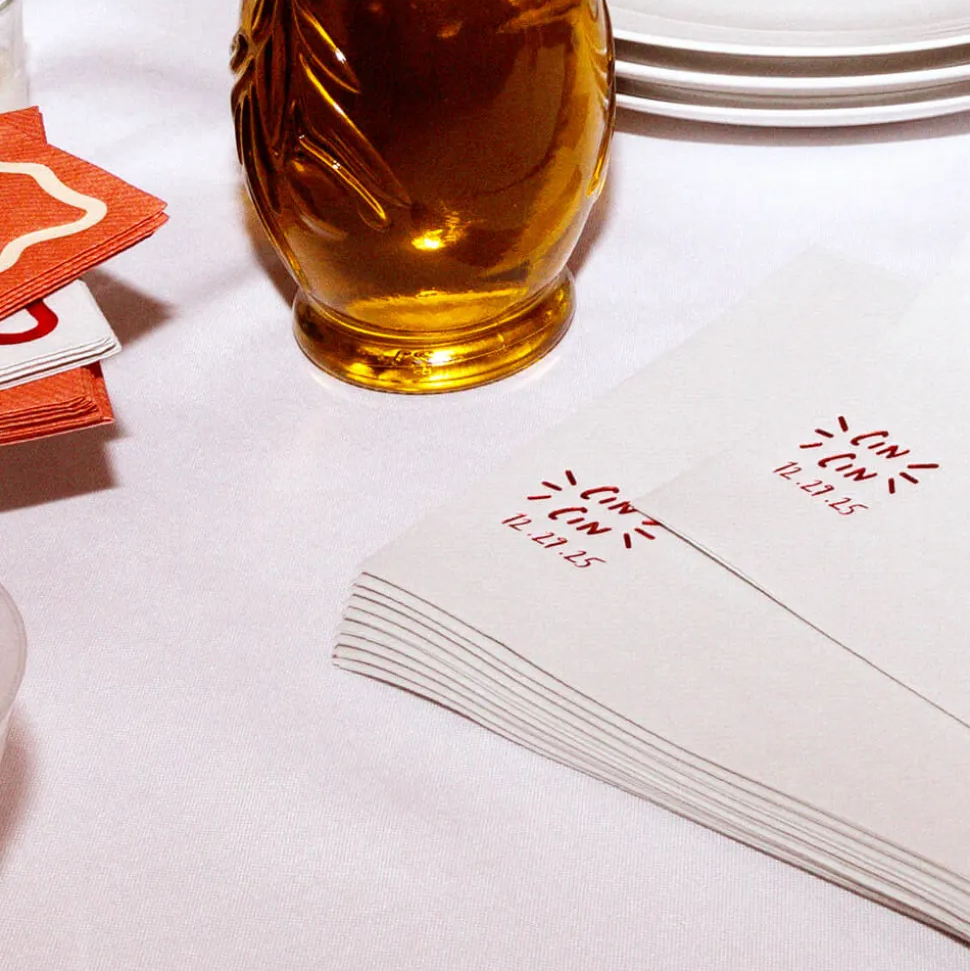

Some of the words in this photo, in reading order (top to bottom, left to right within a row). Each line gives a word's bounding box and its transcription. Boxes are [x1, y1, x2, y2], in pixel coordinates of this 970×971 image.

[850, 430, 910, 459] CIN
[817, 453, 878, 482] CIN
[580, 486, 638, 515] CIN
[547, 507, 612, 536] CIN
